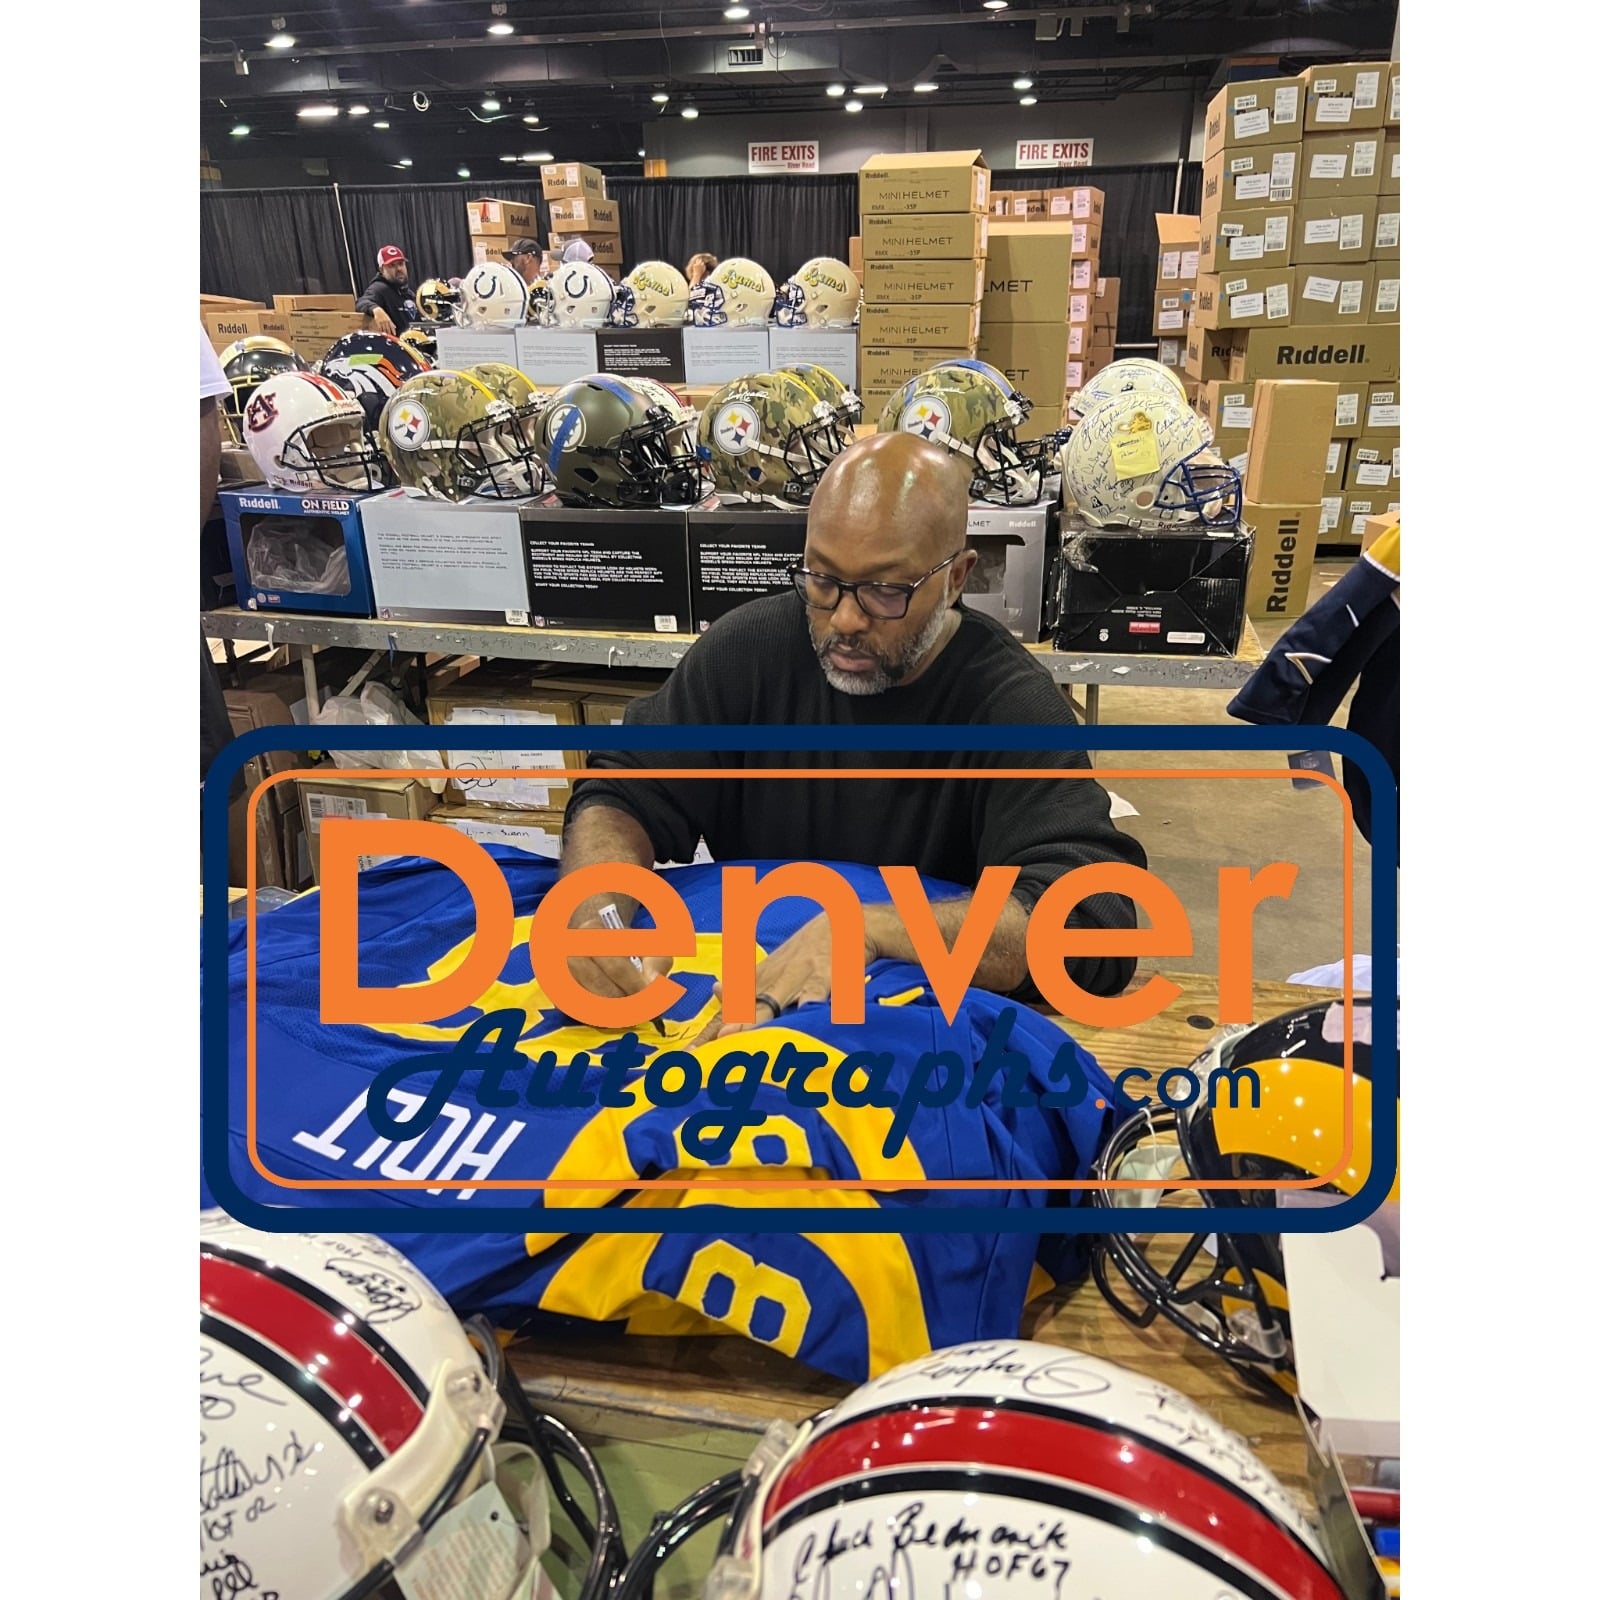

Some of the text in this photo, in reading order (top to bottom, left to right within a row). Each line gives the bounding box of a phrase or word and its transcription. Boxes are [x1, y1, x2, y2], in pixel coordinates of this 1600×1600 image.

[751, 145, 815, 161] FIRE EXITS
[1019, 143, 1089, 160] FIRE EXITS
[218, 323, 248, 334] Riddell
[1276, 344, 1366, 365] Riddell
[238, 497, 279, 510] Riddell
[301, 499, 350, 511] ON FIELD
[1008, 520, 1036, 528] Riddell
[1266, 519, 1300, 612] Riddell
